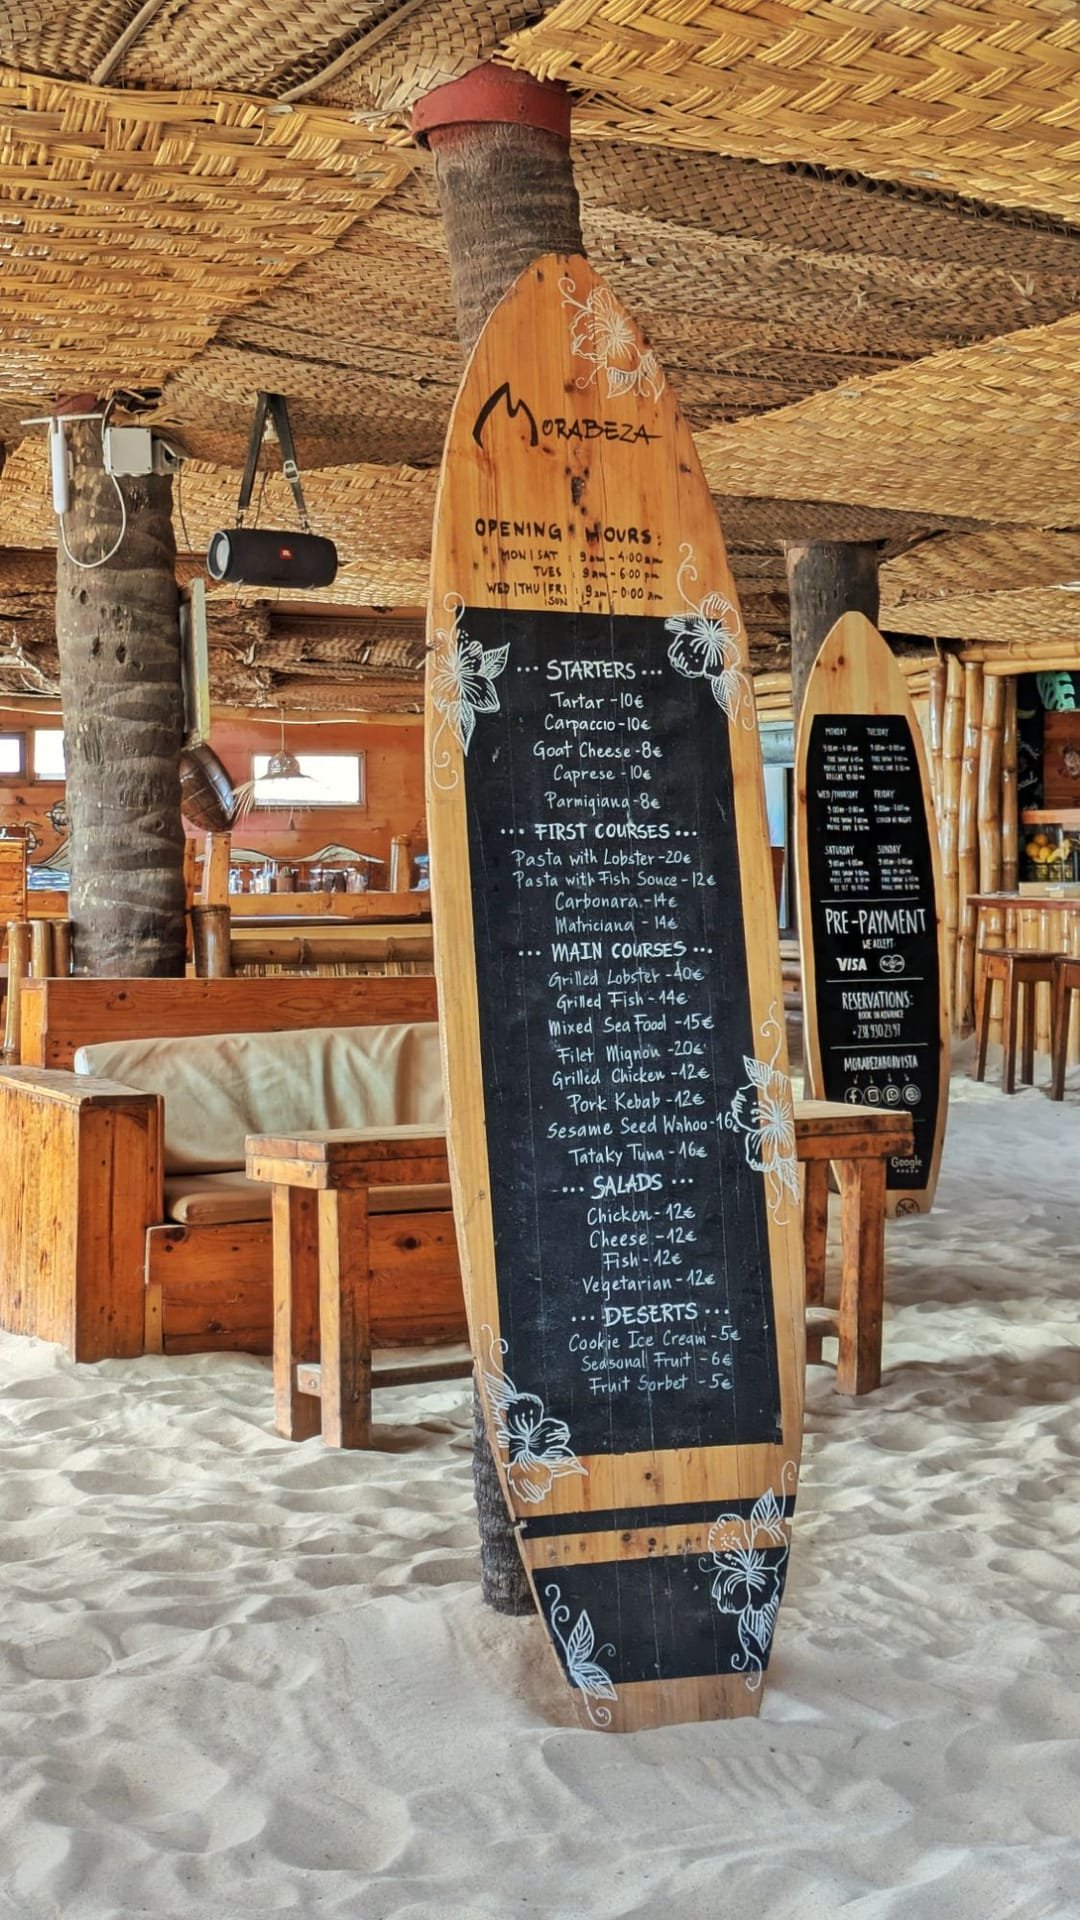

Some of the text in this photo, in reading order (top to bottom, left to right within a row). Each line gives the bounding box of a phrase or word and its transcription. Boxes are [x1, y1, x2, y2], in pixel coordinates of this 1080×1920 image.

[475, 518, 562, 542] OPENING
[533, 566, 561, 577] TUES
[546, 660, 636, 680] STARTERS
[550, 691, 604, 709] Tartar
[544, 713, 616, 737] Carpaccio
[533, 740, 573, 760] Goat
[579, 742, 631, 759] Cheese
[553, 764, 616, 788] Caprese
[544, 791, 630, 816] Parmigiana
[534, 823, 670, 840] FIRST COURSES
[511, 848, 562, 867] Pasta
[568, 848, 598, 866] with
[604, 848, 655, 866] Lobster
[512, 871, 558, 888] Pasta
[565, 872, 595, 887] with
[598, 871, 630, 886] Fish
[636, 871, 678, 887] Souce
[555, 891, 638, 911] Carbonara
[555, 915, 634, 935] Matriciana
[825, 908, 926, 935] PRE-PAYMENT
[551, 941, 687, 962] MAIN COURSES
[836, 957, 868, 971] VISA
[548, 968, 598, 991] Grilled
[607, 967, 660, 985] Lobster
[556, 993, 601, 1015] Grilled
[607, 991, 644, 1008] Fish
[548, 1016, 592, 1037] Mixed
[556, 1047, 594, 1065] Filet
[606, 1044, 661, 1069] Mignon
[552, 1069, 601, 1090] Grilled
[611, 1069, 665, 1084] Chicken
[567, 1094, 608, 1115] Pork
[615, 1092, 661, 1111] Kebab
[547, 1122, 613, 1139] Sesame
[620, 1115, 657, 1135] Seed
[663, 1114, 708, 1135] Wahoo
[568, 1146, 623, 1167] Tataky
[626, 1143, 664, 1161] Tuna
[890, 1155, 923, 1170] Google
[591, 1174, 663, 1199] SALADS
[587, 1206, 653, 1225] Chicken
[589, 1230, 648, 1248] Cheese
[603, 1252, 639, 1271] Fish
[582, 1276, 672, 1301] Vegetarian
[603, 1303, 698, 1327] DESERTS
[568, 1331, 620, 1352] Cookie
[628, 1330, 654, 1348] Ice
[663, 1330, 707, 1346] Cream
[581, 1350, 648, 1372] Seasonal
[653, 1351, 692, 1367] Fruit
[588, 1377, 629, 1395] Fruit
[637, 1373, 688, 1392] Sorbet
